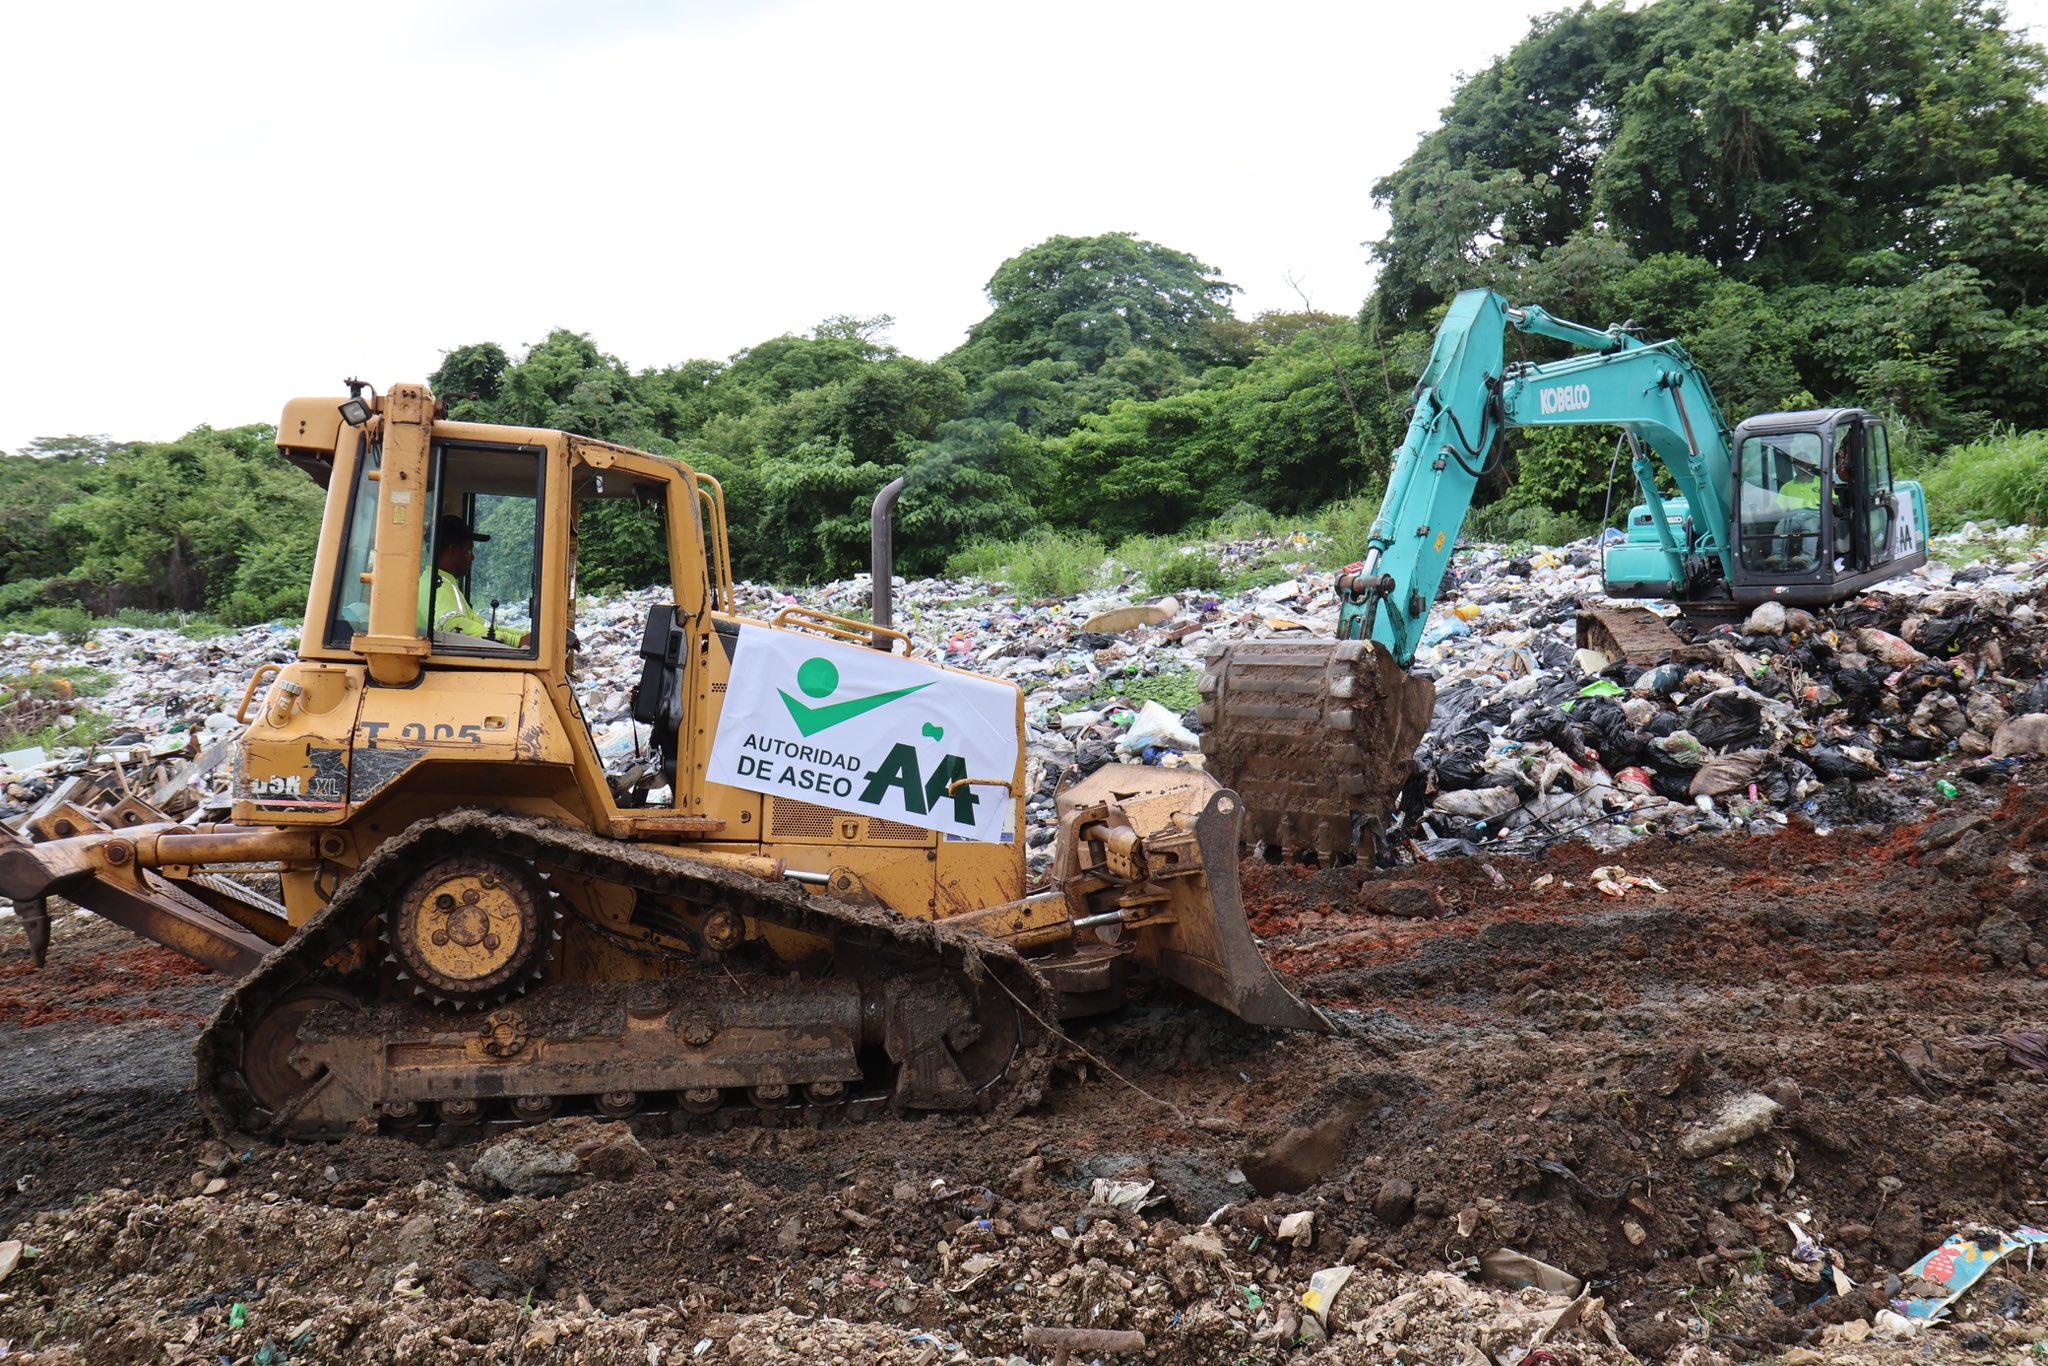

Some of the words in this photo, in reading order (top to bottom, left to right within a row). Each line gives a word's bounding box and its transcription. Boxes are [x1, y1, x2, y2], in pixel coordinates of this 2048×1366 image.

[1540, 384, 1590, 415] KOBELCO
[743, 733, 861, 772] AUTORIDAD
[313, 777, 340, 797] XL
[737, 755, 773, 781] DE
[778, 765, 853, 798] ASEO
